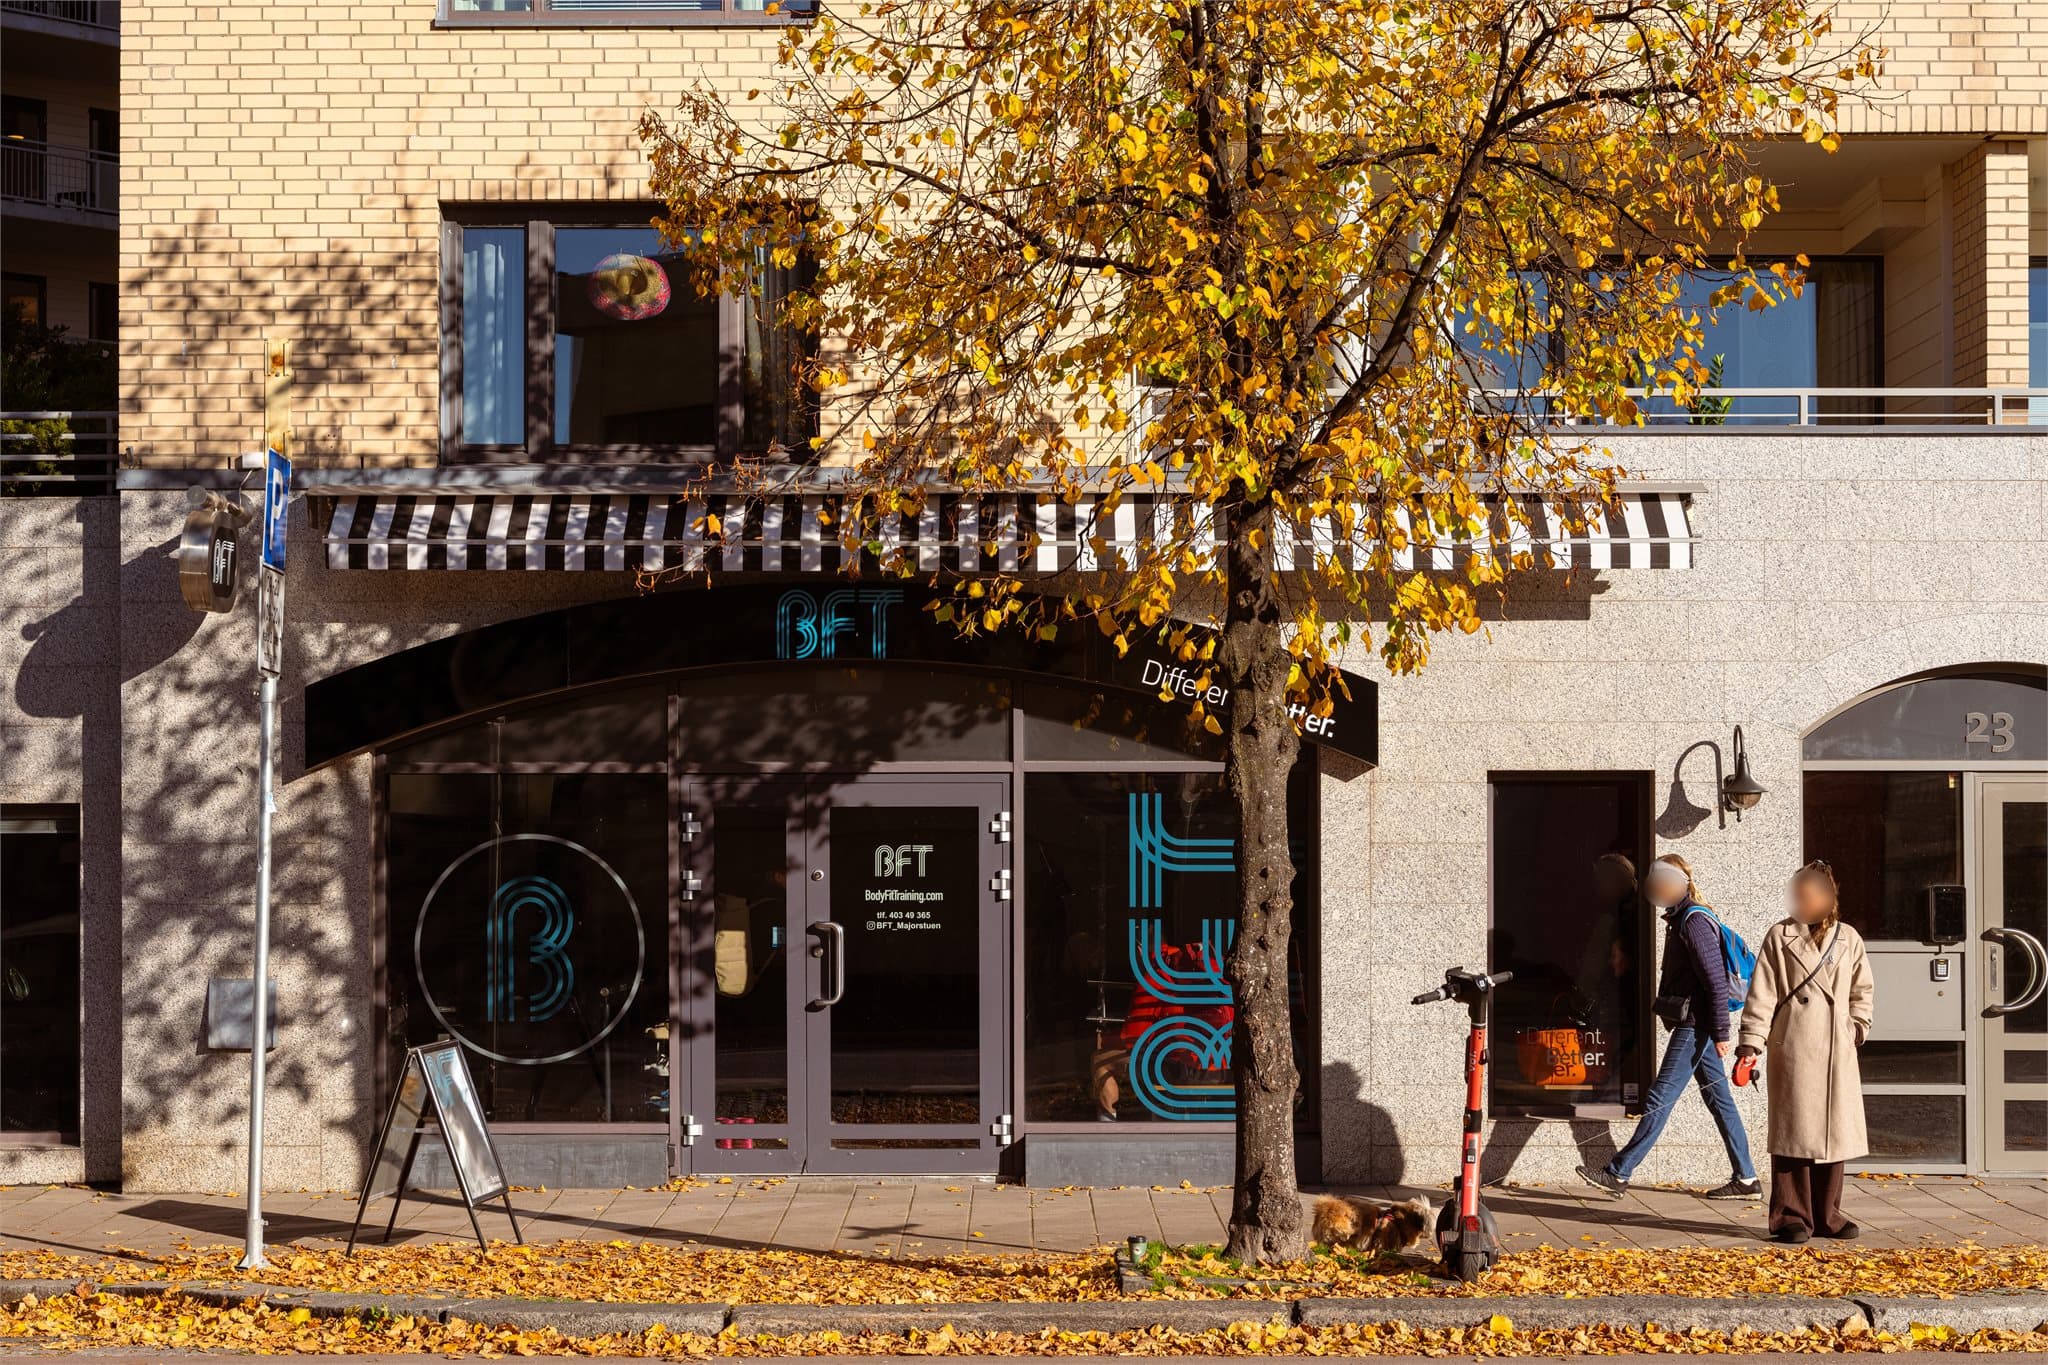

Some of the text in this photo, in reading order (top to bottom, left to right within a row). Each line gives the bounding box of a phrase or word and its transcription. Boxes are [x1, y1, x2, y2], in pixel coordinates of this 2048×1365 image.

[269, 468, 284, 551] P
[212, 538, 235, 586] BFT
[776, 589, 904, 659] BFT
[1965, 711, 2015, 752] 23
[874, 844, 934, 877] BFT
[865, 889, 944, 904] BodyFitTraining.com
[876, 911, 931, 919] tlf. 403 49 365
[876, 921, 941, 931] BFT_Majorstuen
[487, 875, 575, 1022] B
[1128, 792, 1237, 1121] BFT
[1527, 1026, 1606, 1045] Different.
[1546, 1047, 1606, 1066] Better.
